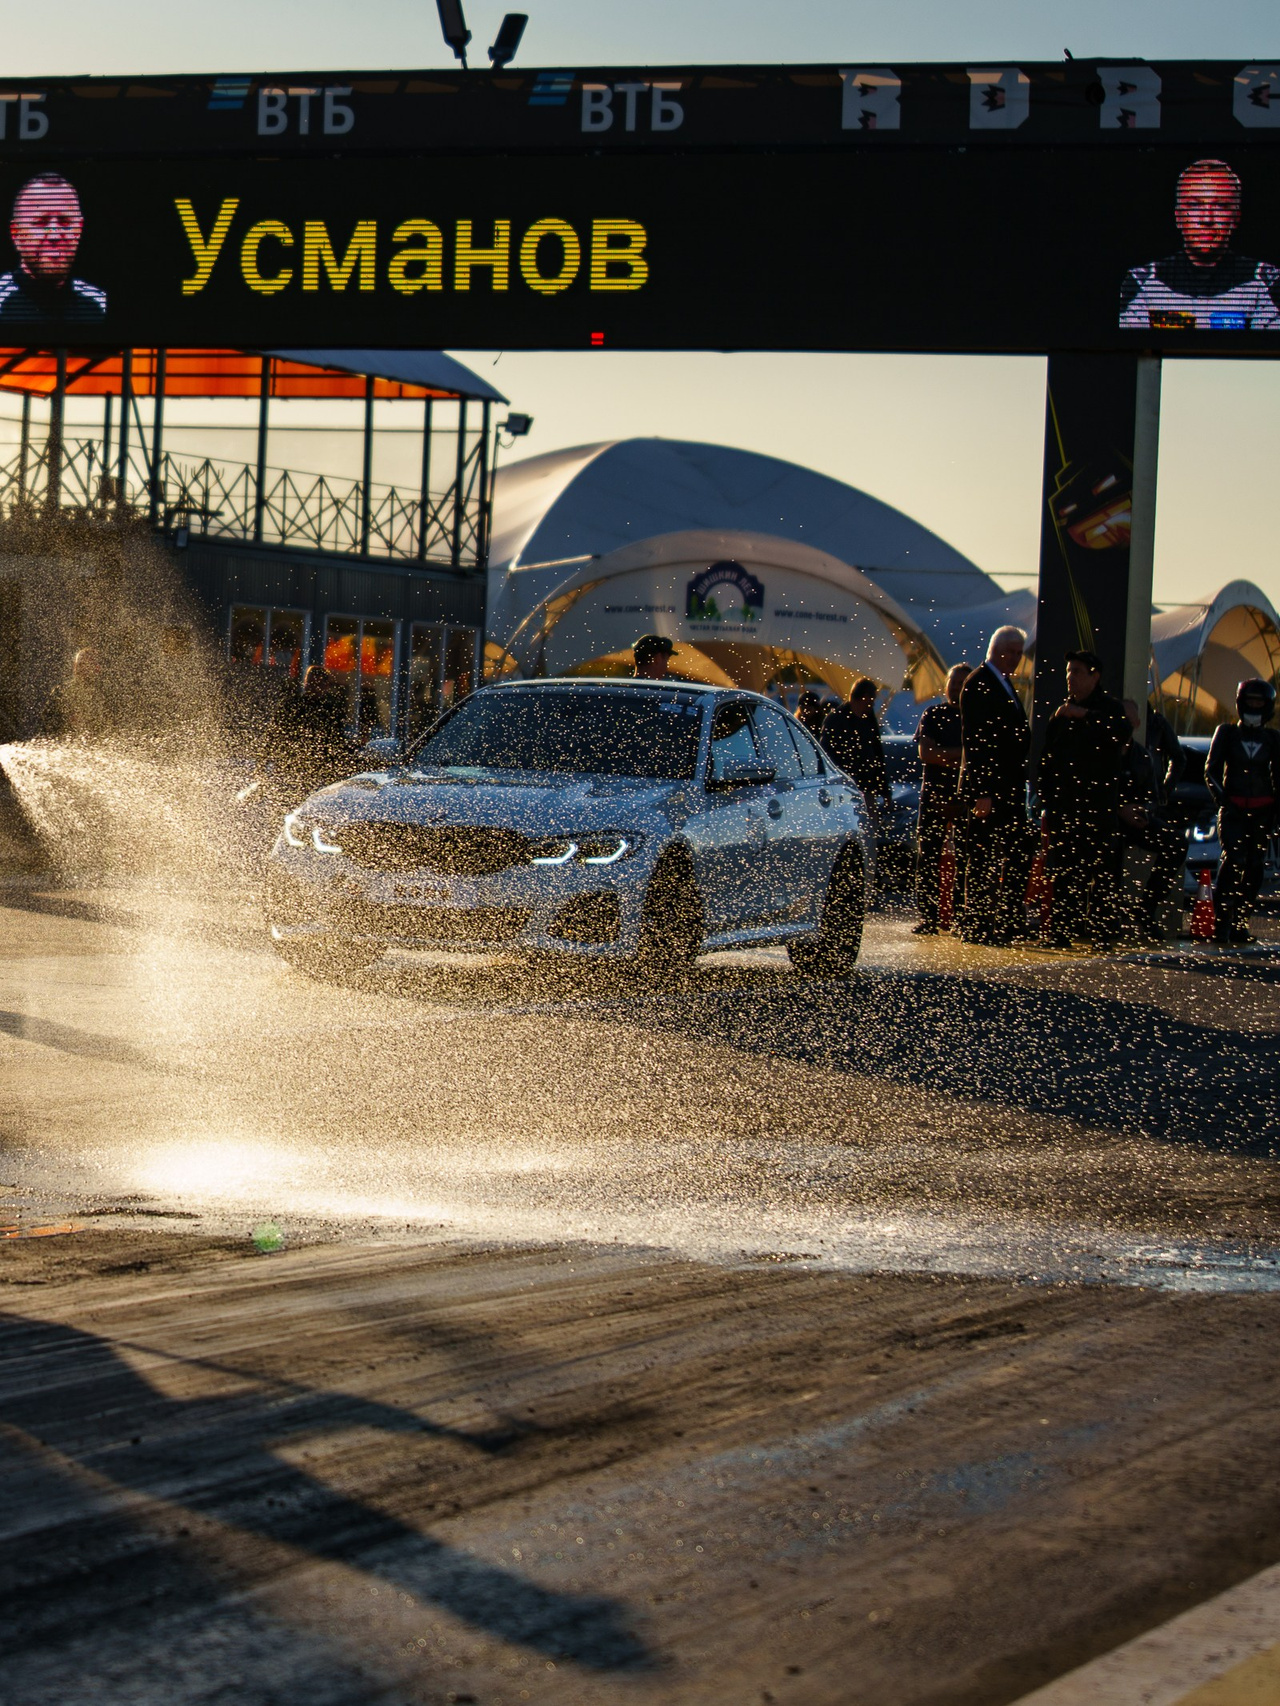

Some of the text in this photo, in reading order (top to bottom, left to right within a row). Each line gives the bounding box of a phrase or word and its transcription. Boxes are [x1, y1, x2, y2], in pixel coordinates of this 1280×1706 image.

[257, 86, 355, 136] ВТБ
[581, 82, 684, 133] ВТБ
[174, 196, 649, 296] Усманов
[773, 608, 848, 623] www.cone-forest.ru
